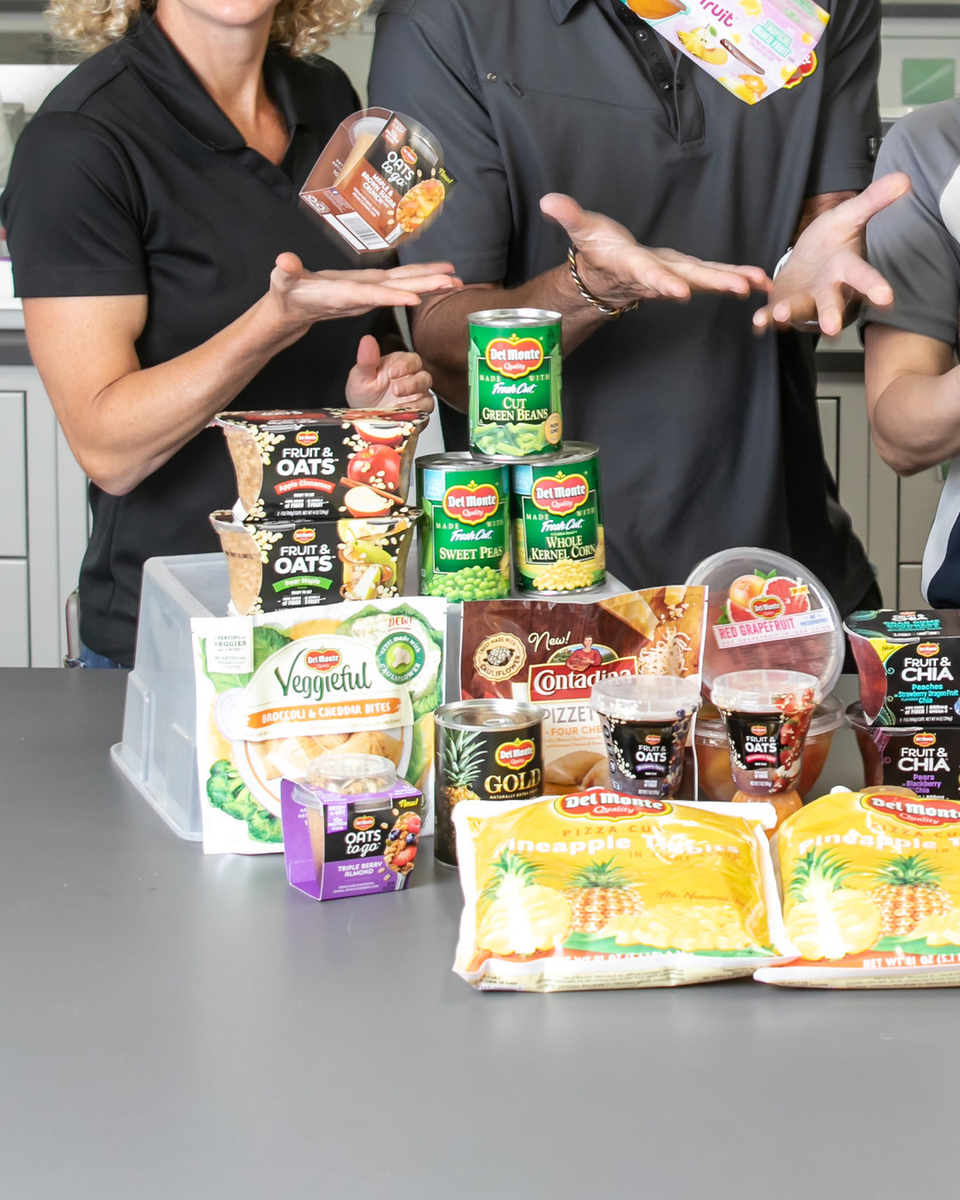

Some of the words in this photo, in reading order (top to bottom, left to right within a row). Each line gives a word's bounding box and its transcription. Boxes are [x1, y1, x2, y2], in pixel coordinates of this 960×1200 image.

[387, 151, 415, 180] OATS
[490, 349, 506, 360] Del
[508, 349, 540, 360] Monte
[504, 363, 525, 371] Quality
[479, 374, 501, 382] MADE
[492, 382, 516, 395] Fresh
[516, 383, 537, 394] Cut
[503, 397, 526, 409] CUT
[482, 407, 514, 421] GREEN
[517, 408, 548, 421] BEANS
[282, 448, 320, 458] FRUIT
[322, 447, 333, 457] &
[277, 458, 336, 476] OATS
[279, 481, 297, 491] Apple
[299, 480, 332, 490] Cinnamon
[536, 487, 553, 499] Del
[554, 485, 585, 497] Monte
[448, 496, 465, 507] Del
[466, 495, 496, 507] Monte
[551, 500, 573, 508] Quality
[462, 509, 483, 517] Quality
[541, 520, 565, 533] Fresh
[564, 518, 585, 530] Cut
[450, 529, 474, 542] Fresh
[475, 530, 494, 541] Cut
[546, 535, 583, 548] WHOLE
[280, 545, 317, 556] FRUIT
[320, 544, 330, 554] &
[439, 547, 477, 560] SWEET
[479, 547, 503, 559] PEAS
[531, 548, 569, 561] KERNEL
[572, 544, 596, 558] CORN
[274, 555, 333, 574] OATS
[719, 627, 738, 639] RED
[740, 618, 795, 636] GRAPEFRUIT
[528, 631, 571, 652] New!
[904, 658, 939, 667] FRUIT
[940, 657, 951, 666] &
[274, 648, 373, 701] Veggieful
[901, 667, 954, 682] CHIA
[262, 709, 305, 723] BROCCOLI
[309, 709, 316, 718] &
[319, 703, 362, 718] CHEDDAR
[365, 702, 390, 714] BITES
[500, 750, 513, 760] Del
[514, 747, 535, 758] Monte
[745, 743, 777, 753] OATS
[901, 747, 935, 757] FRUIT
[937, 747, 948, 757] &
[636, 752, 666, 762] OATS
[898, 757, 950, 772] CHIA
[484, 768, 541, 794] GOLD
[907, 780, 941, 788] Blackberry
[566, 792, 597, 808] Del
[600, 793, 663, 809] Monte
[872, 798, 902, 811] Del
[593, 805, 634, 814] Quality
[900, 813, 939, 825] Quality
[345, 830, 381, 844] OATS
[799, 829, 937, 854] Pineapple
[337, 864, 359, 872] TRIPLE
[345, 869, 373, 877] ALMOND
